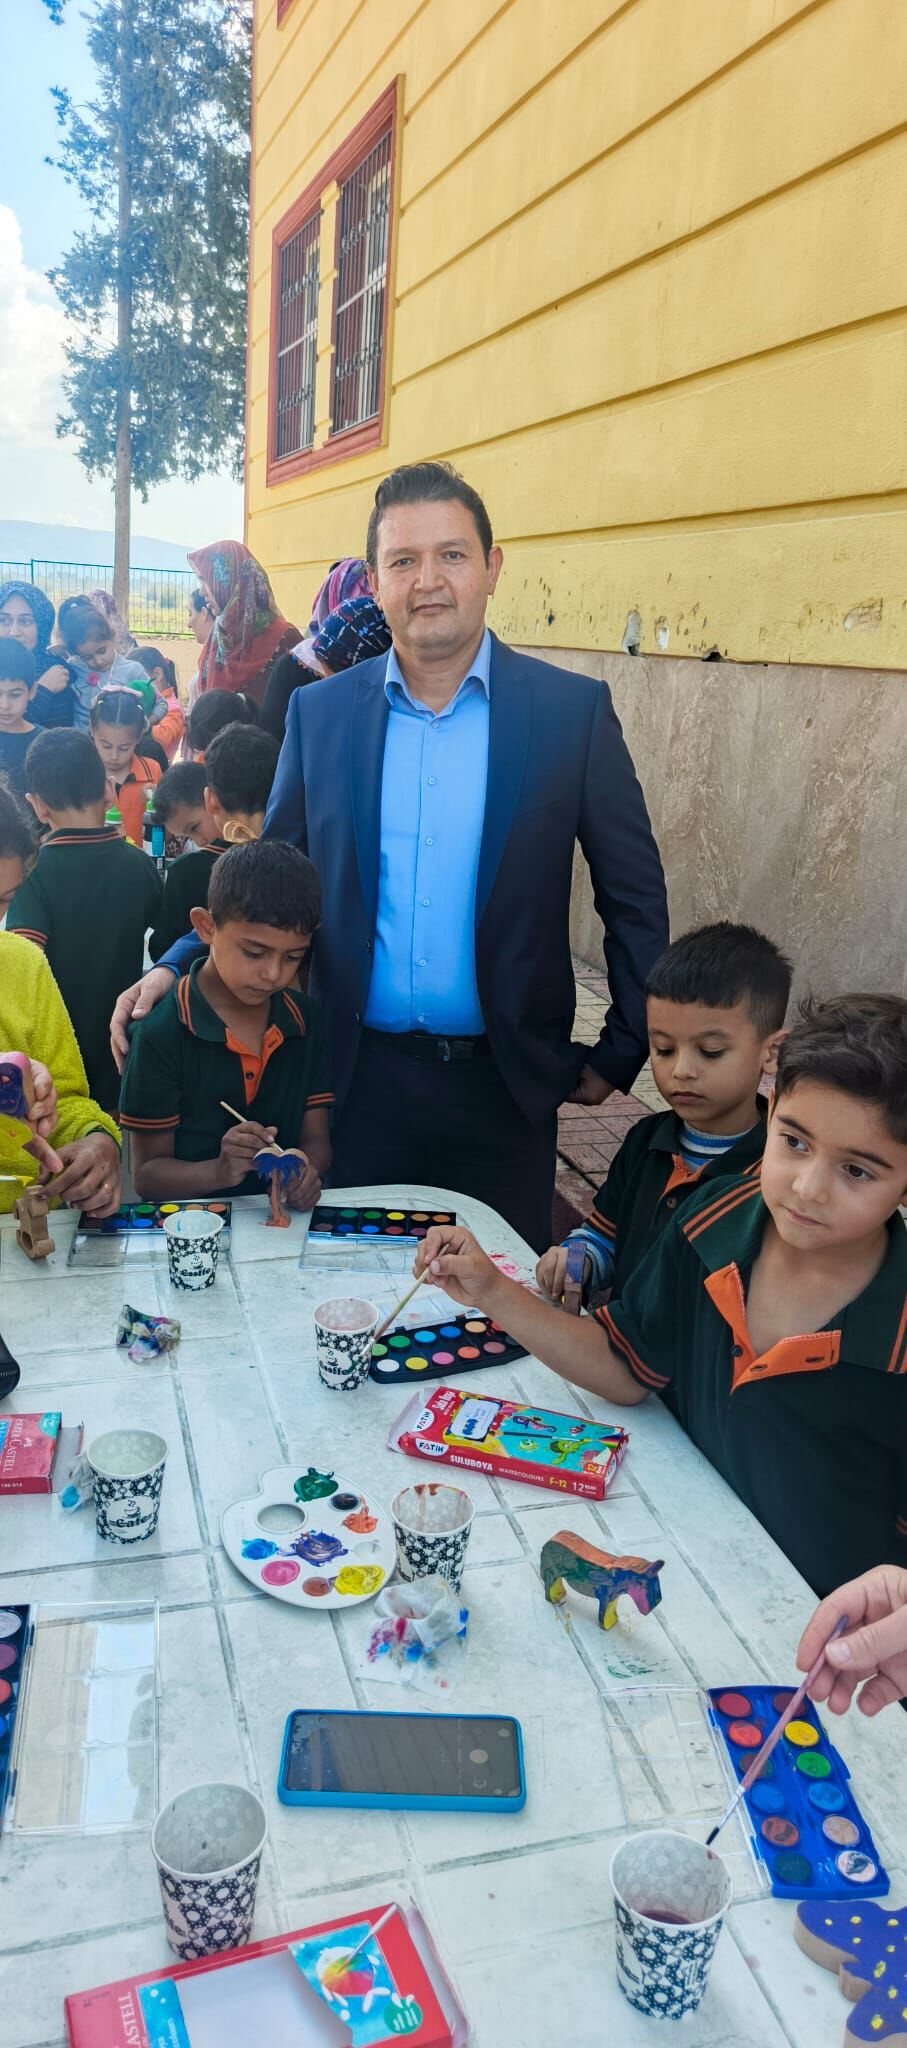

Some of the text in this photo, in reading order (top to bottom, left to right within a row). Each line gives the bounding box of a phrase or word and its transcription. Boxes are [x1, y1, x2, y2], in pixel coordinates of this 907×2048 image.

[449, 1454, 494, 1472] SULUBOYA
[549, 1477, 568, 1489] F-12
[572, 1481, 585, 1493] 12
[118, 1991, 141, 2048] ASTELL
